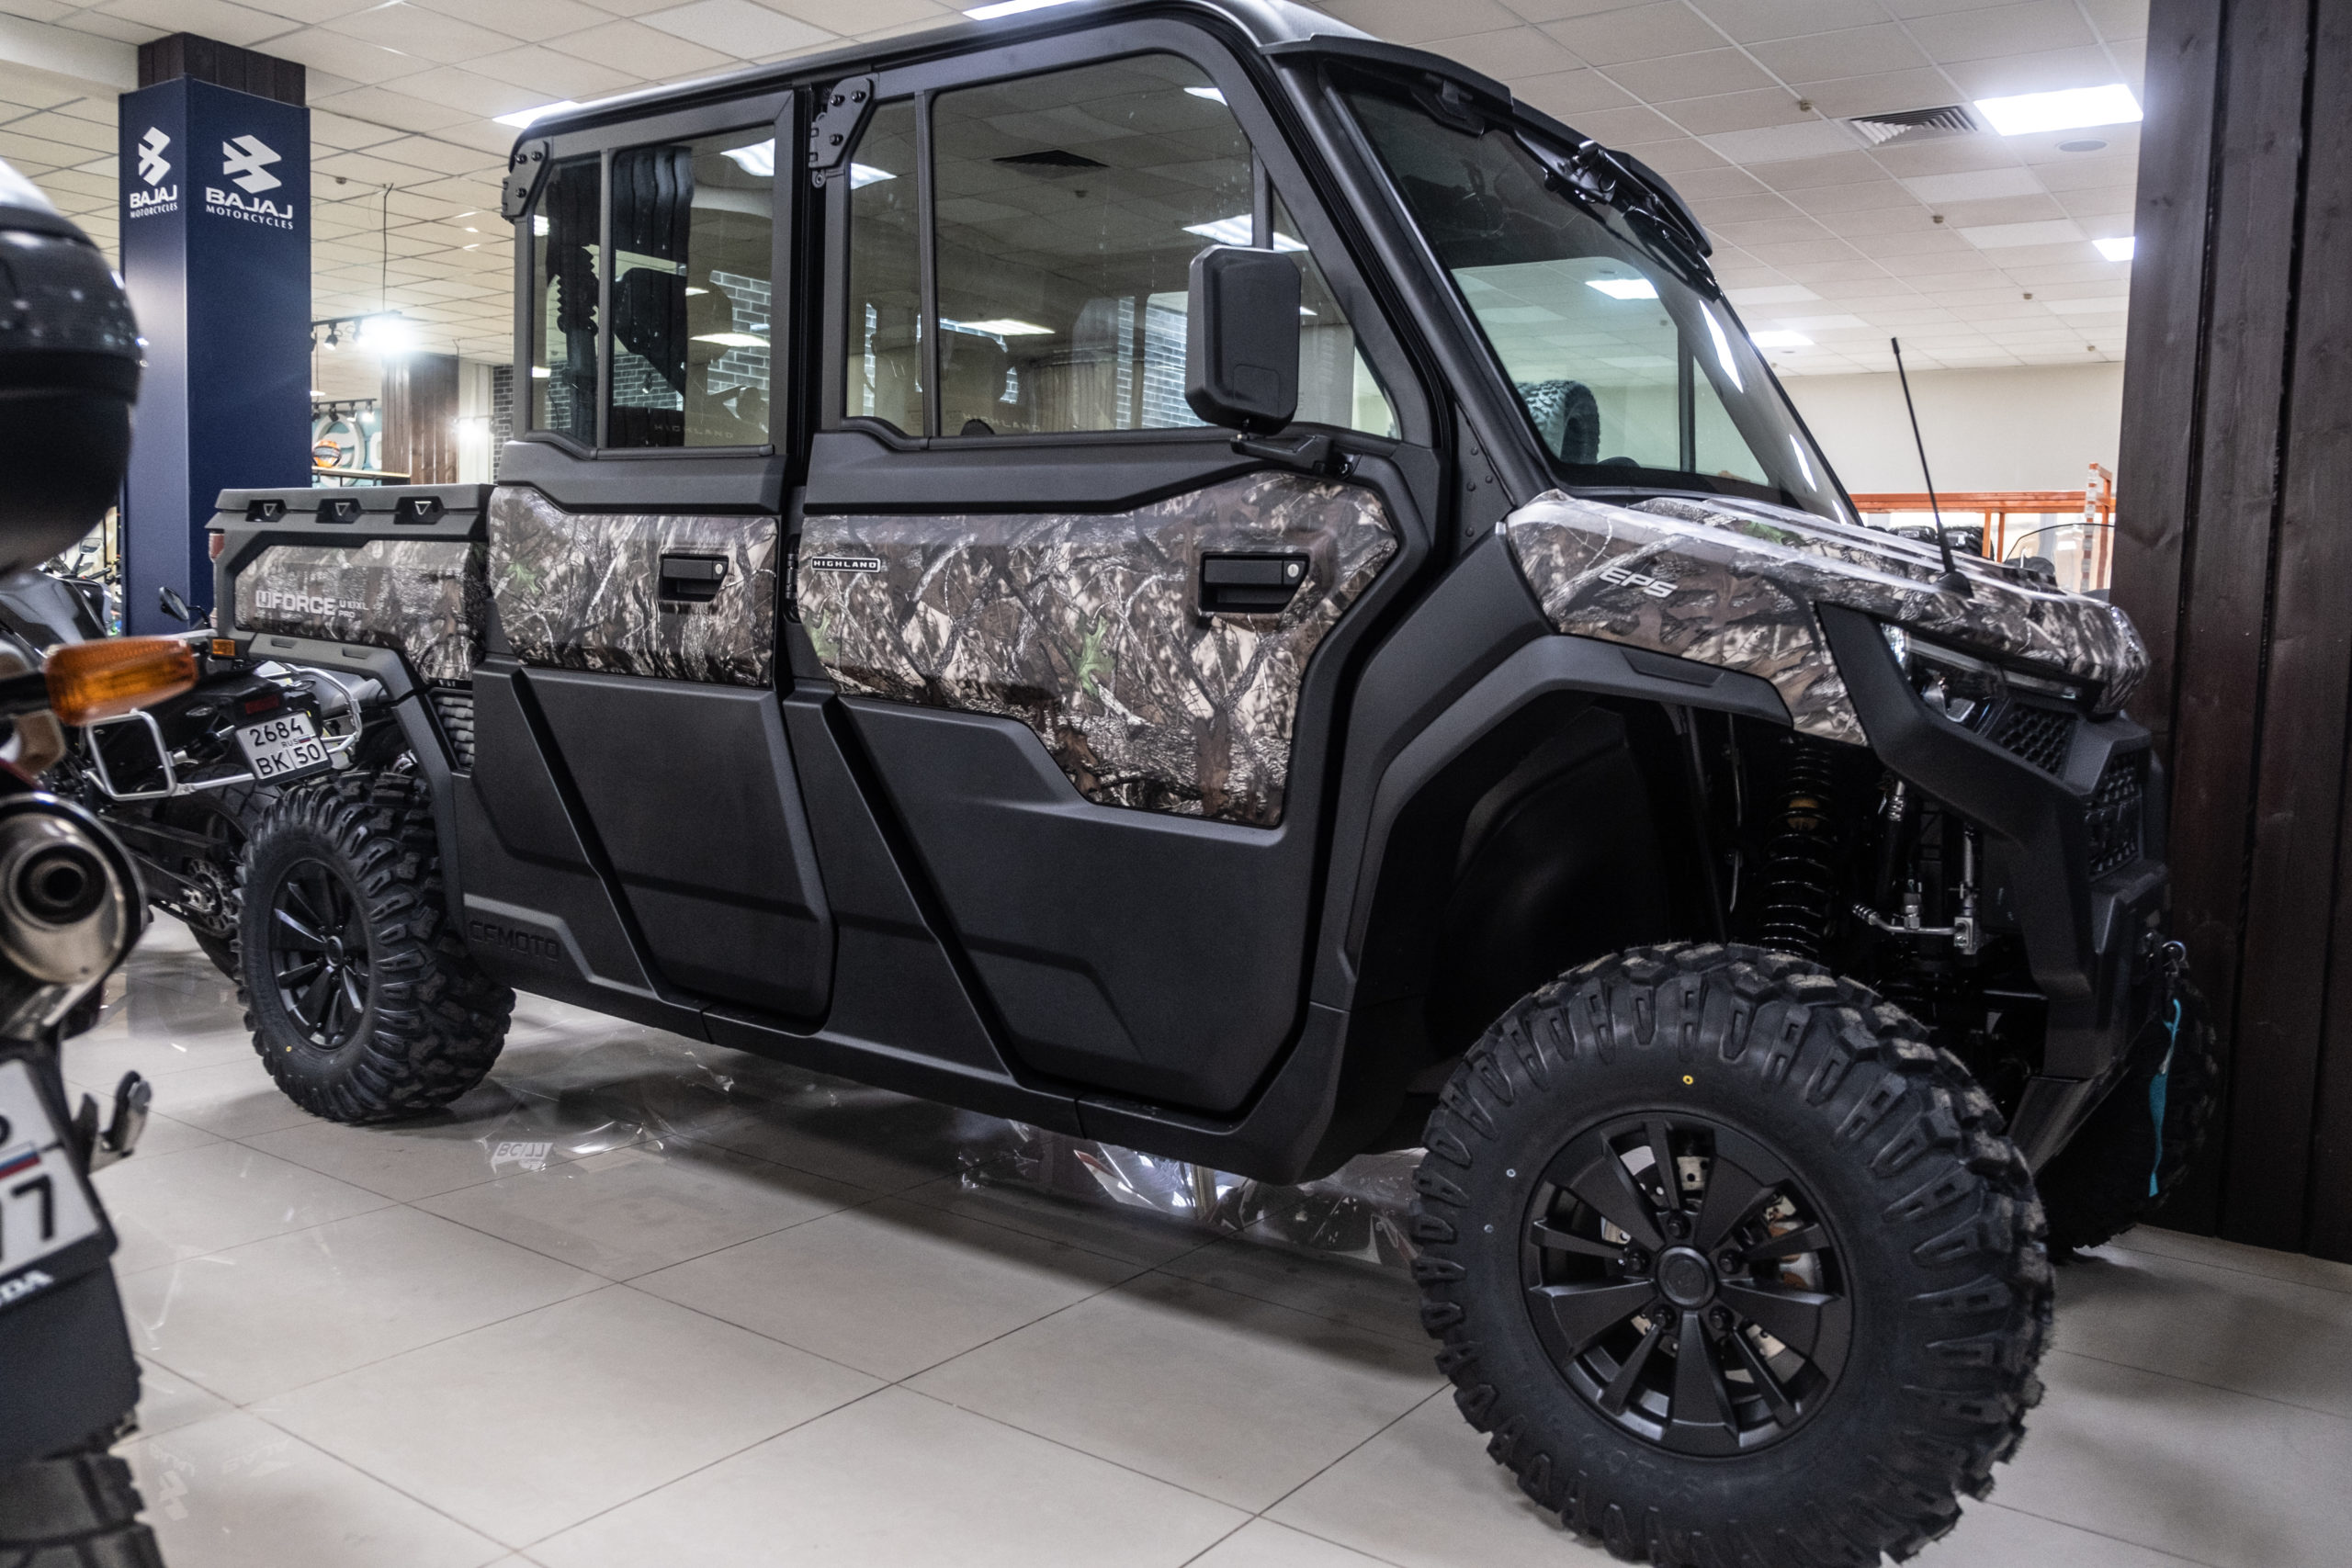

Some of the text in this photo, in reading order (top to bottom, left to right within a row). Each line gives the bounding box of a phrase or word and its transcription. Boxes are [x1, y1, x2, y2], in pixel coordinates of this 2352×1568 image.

[130, 185, 178, 209] BAJAJ
[205, 186, 294, 220] BAJAJ
[130, 202, 178, 219] MOTORCYCLES
[205, 204, 294, 230] MOTORCYCLES
[813, 559, 877, 569] HIGHLAND
[1599, 566, 1679, 598] EPS
[337, 609, 356, 619] PRO
[249, 717, 304, 747] 2684
[281, 739, 300, 749] RUS
[294, 743, 321, 764] 50
[469, 919, 560, 962] CFMOTO
[0, 1174, 55, 1263] 7
